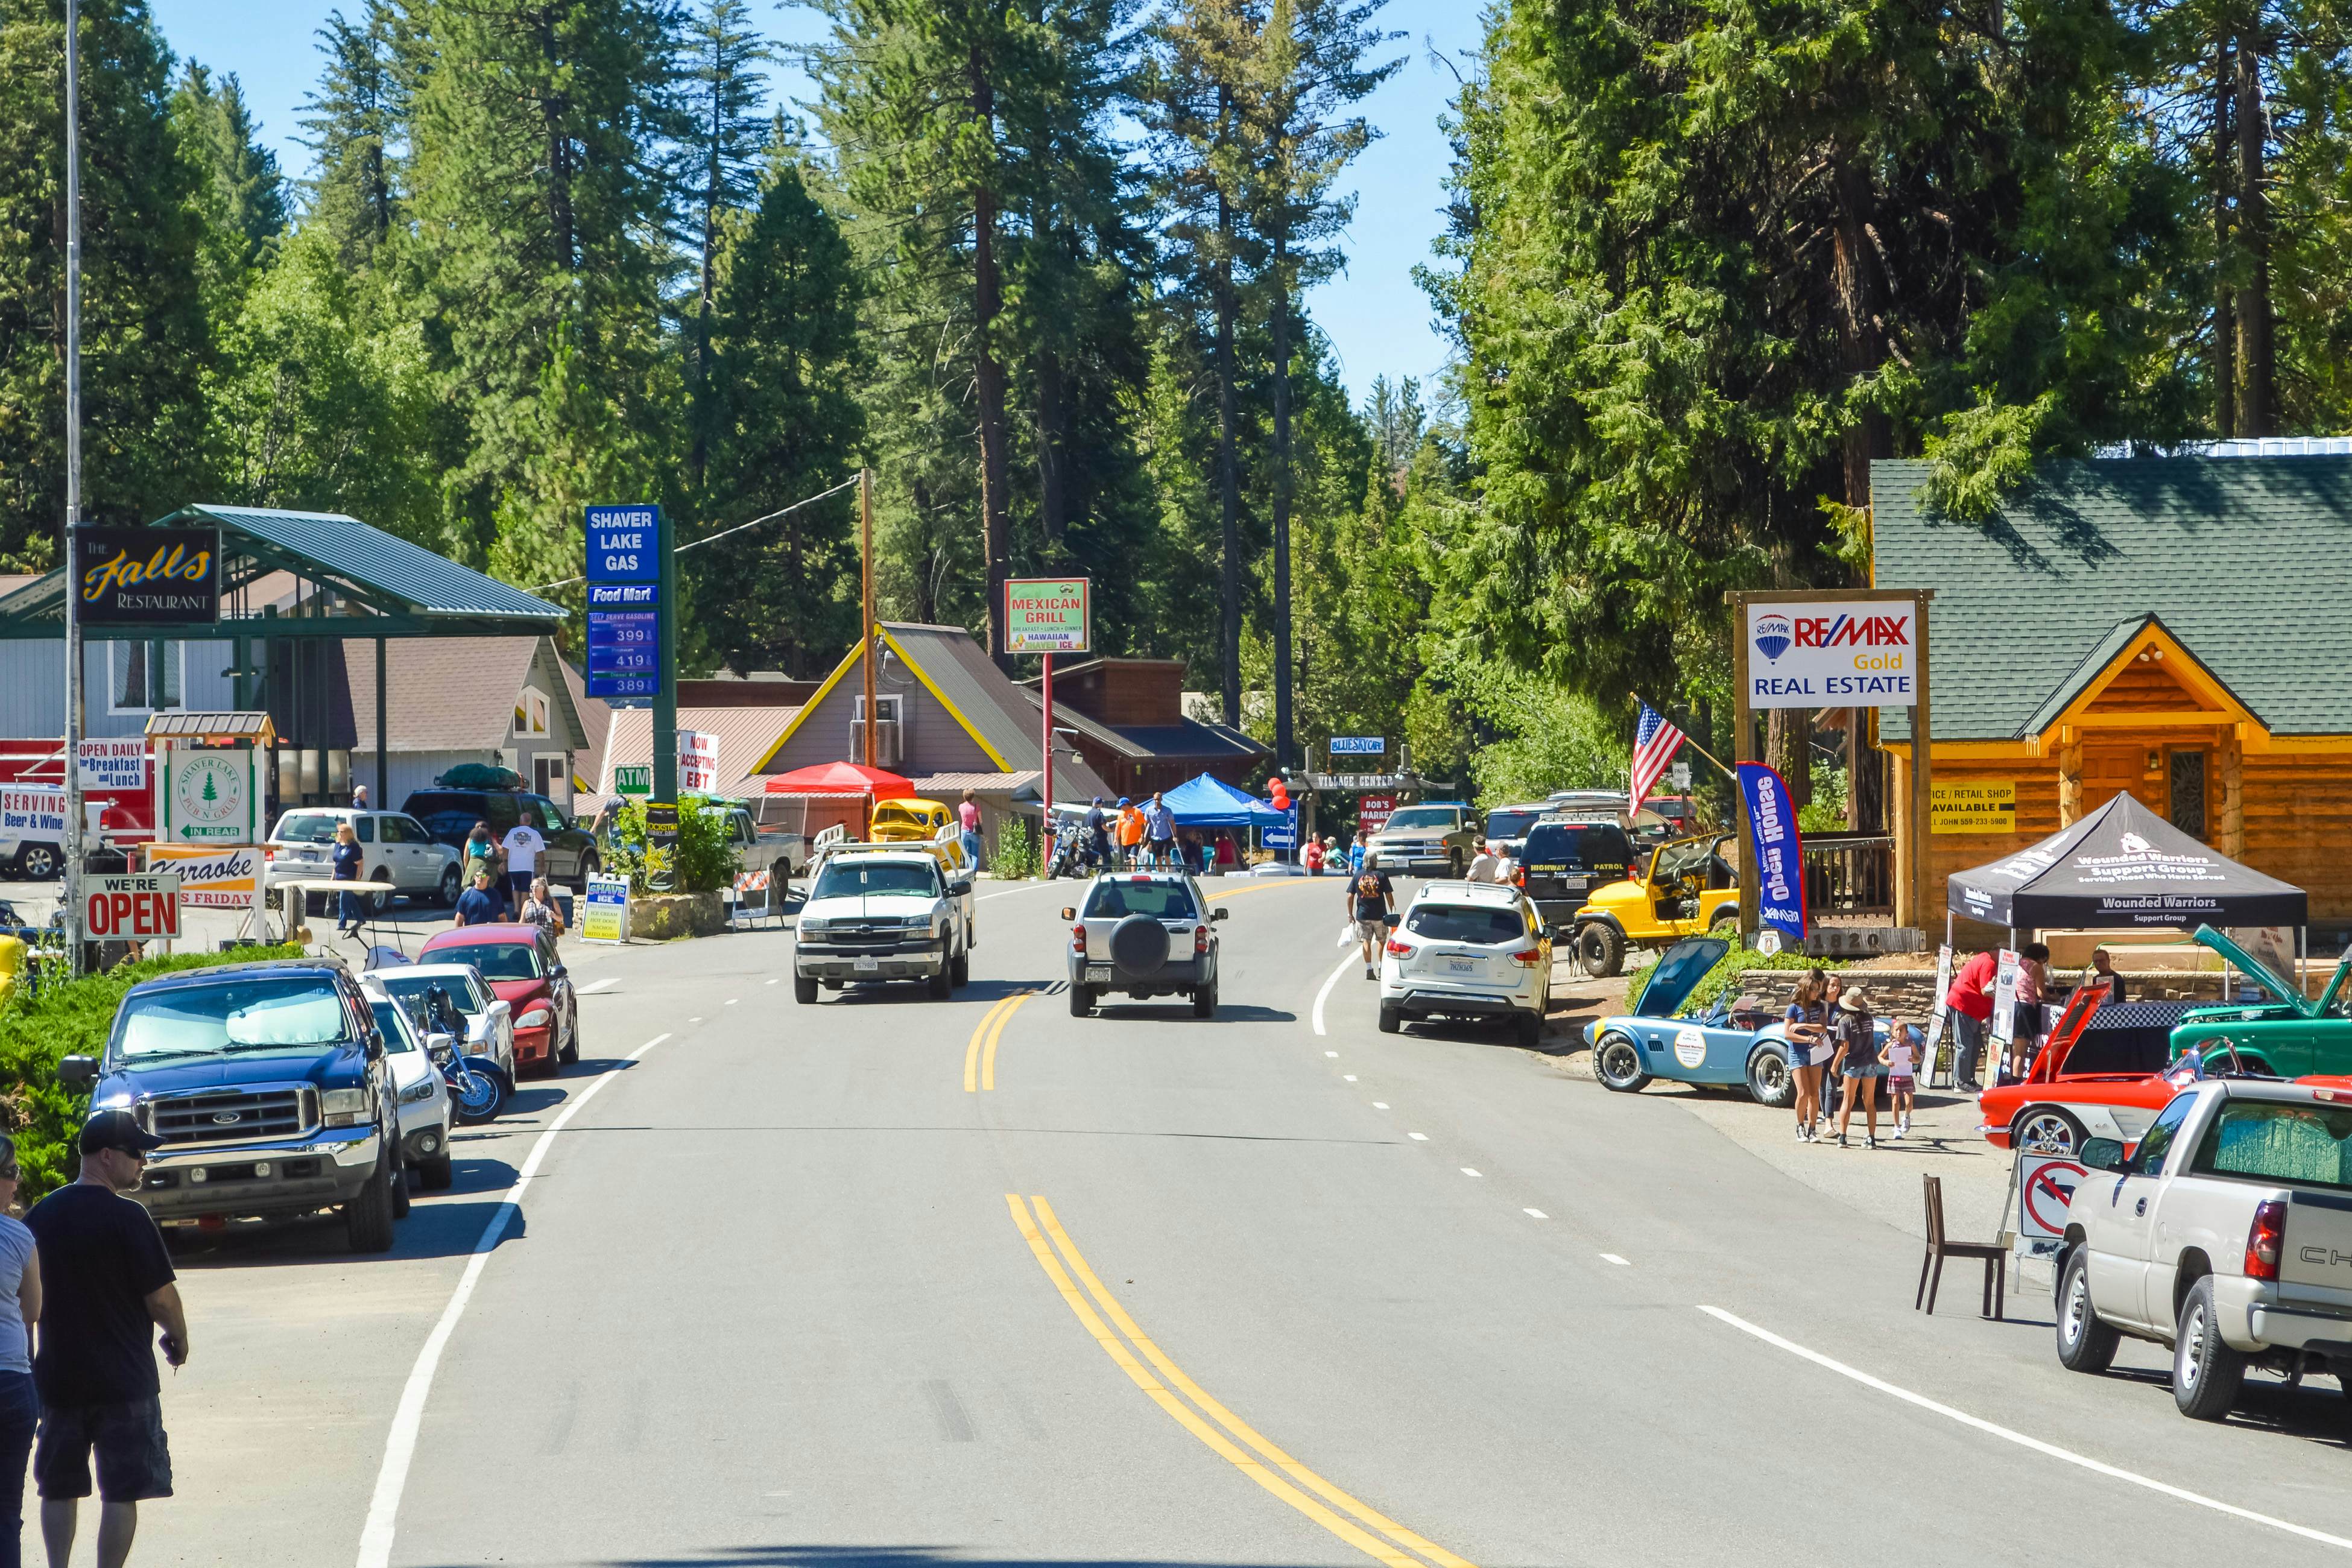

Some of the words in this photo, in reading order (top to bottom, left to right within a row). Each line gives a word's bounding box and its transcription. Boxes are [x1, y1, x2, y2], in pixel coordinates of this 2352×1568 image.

[591, 513, 652, 529] SHAVER
[88, 542, 108, 554] THE
[601, 534, 642, 549] LAKE
[605, 555, 638, 571] GAS
[83, 543, 210, 602] Falls
[593, 588, 621, 602] Food
[623, 587, 651, 601] Mart
[1012, 598, 1080, 610] MEXICAN
[1026, 612, 1066, 623] GRILL
[1756, 622, 1790, 634] RE/MAX
[1795, 614, 1909, 648] RE/MAX
[617, 630, 644, 641] 399
[1025, 641, 1057, 650] SHAVED
[616, 655, 644, 666] 419
[1854, 653, 1903, 670] Gold
[617, 680, 644, 691] 389
[1756, 678, 1815, 695] REAL
[1827, 677, 1910, 693] ESTATE
[690, 736, 708, 750] NOW
[80, 744, 107, 757] OPEN
[112, 744, 141, 756] DAILY
[80, 759, 89, 768] for
[90, 758, 140, 771] Breakfast
[681, 753, 715, 770] ACCEPTING
[182, 759, 213, 784] SHAVER
[217, 761, 238, 782] LAKE
[616, 768, 649, 786] ATM
[98, 773, 109, 782] and
[110, 773, 140, 786] Lunch
[686, 771, 709, 789] EBT
[1318, 776, 1354, 787] VILLAGE
[1359, 775, 1394, 786] CENTER
[1931, 790, 1946, 799] ICE
[1955, 790, 1984, 798] RETAIL
[1987, 789, 2012, 798] SHOP
[4, 793, 65, 813] SERVING
[183, 797, 199, 815] PUB
[213, 797, 236, 819] GRUB
[1366, 800, 1389, 809] BOB'S
[1932, 803, 1996, 812] AVAILABLE
[4, 812, 27, 827] Beer
[30, 814, 37, 828] &
[40, 815, 63, 830] Wine
[2078, 852, 2146, 865] Wounded
[2148, 853, 2209, 864] Warriors
[2091, 864, 2156, 877] Support
[2158, 864, 2207, 875] Group
[105, 879, 158, 891] WE'RE
[588, 884, 625, 897] SHAVE
[194, 893, 253, 905] FRIDAY
[2103, 896, 2161, 908] Wounded
[2164, 896, 2216, 908] Warriors
[88, 892, 177, 935] OPEN
[2134, 914, 2163, 923] Support
[1794, 933, 1879, 949] 1820
